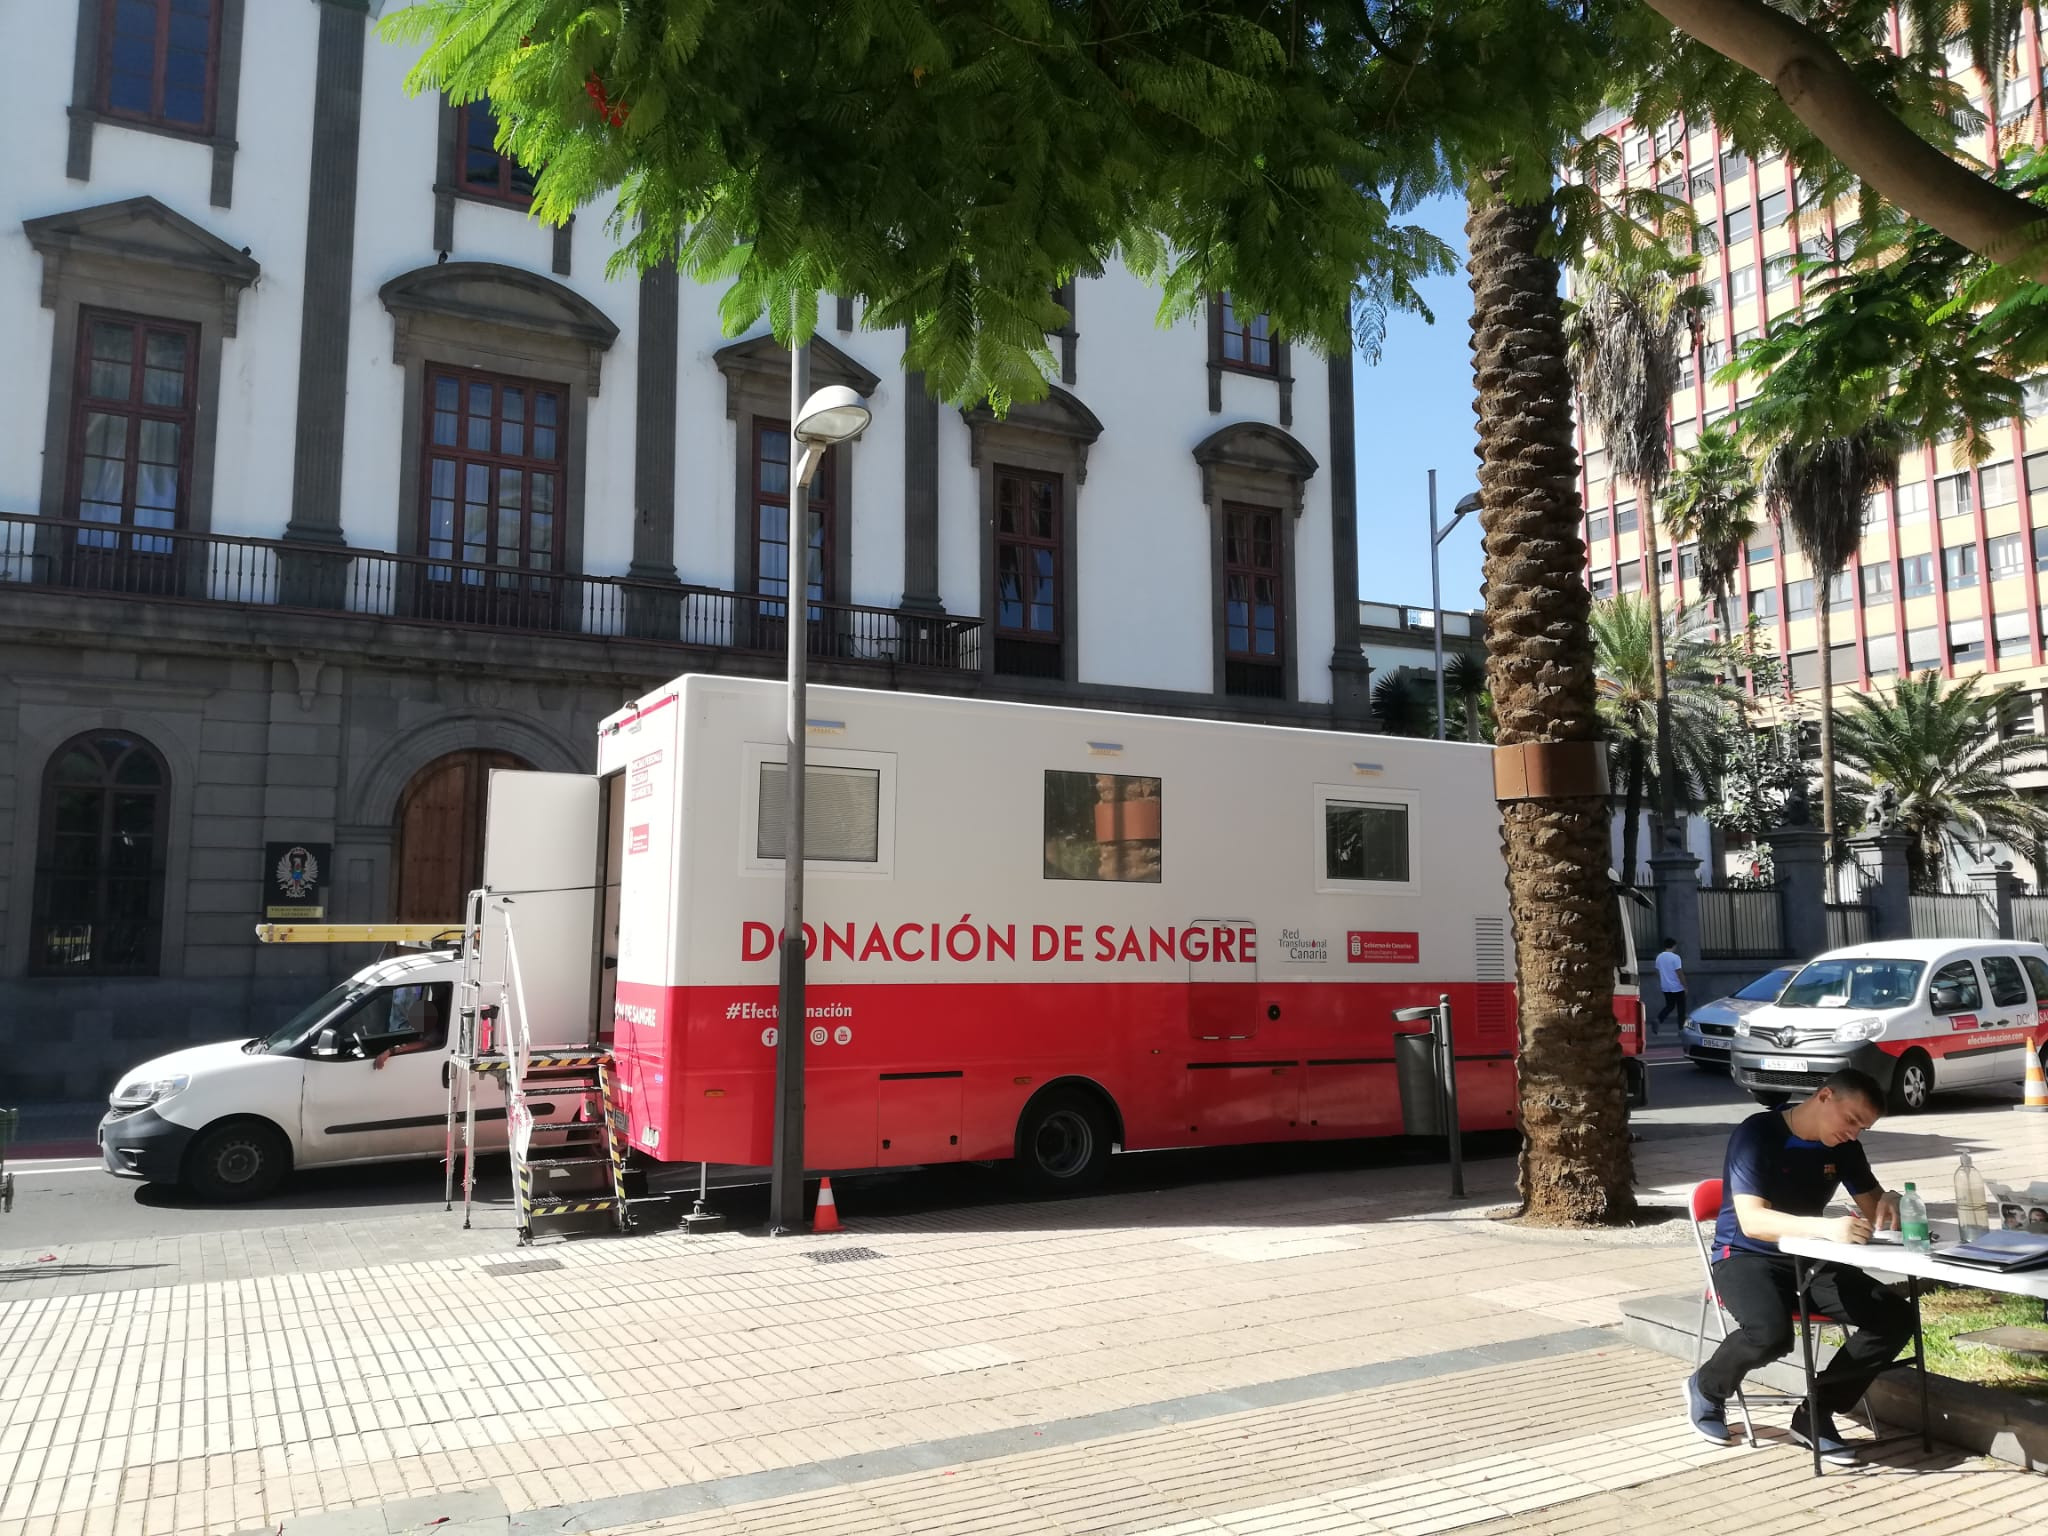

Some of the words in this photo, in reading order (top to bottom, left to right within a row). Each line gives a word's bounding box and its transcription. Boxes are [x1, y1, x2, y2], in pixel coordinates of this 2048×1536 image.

[741, 913, 1015, 962] DONACIÓN
[1032, 924, 1084, 962] DE
[1094, 924, 1257, 963] SANGRE
[1282, 928, 1300, 940] Red
[1290, 947, 1328, 960] Canaria
